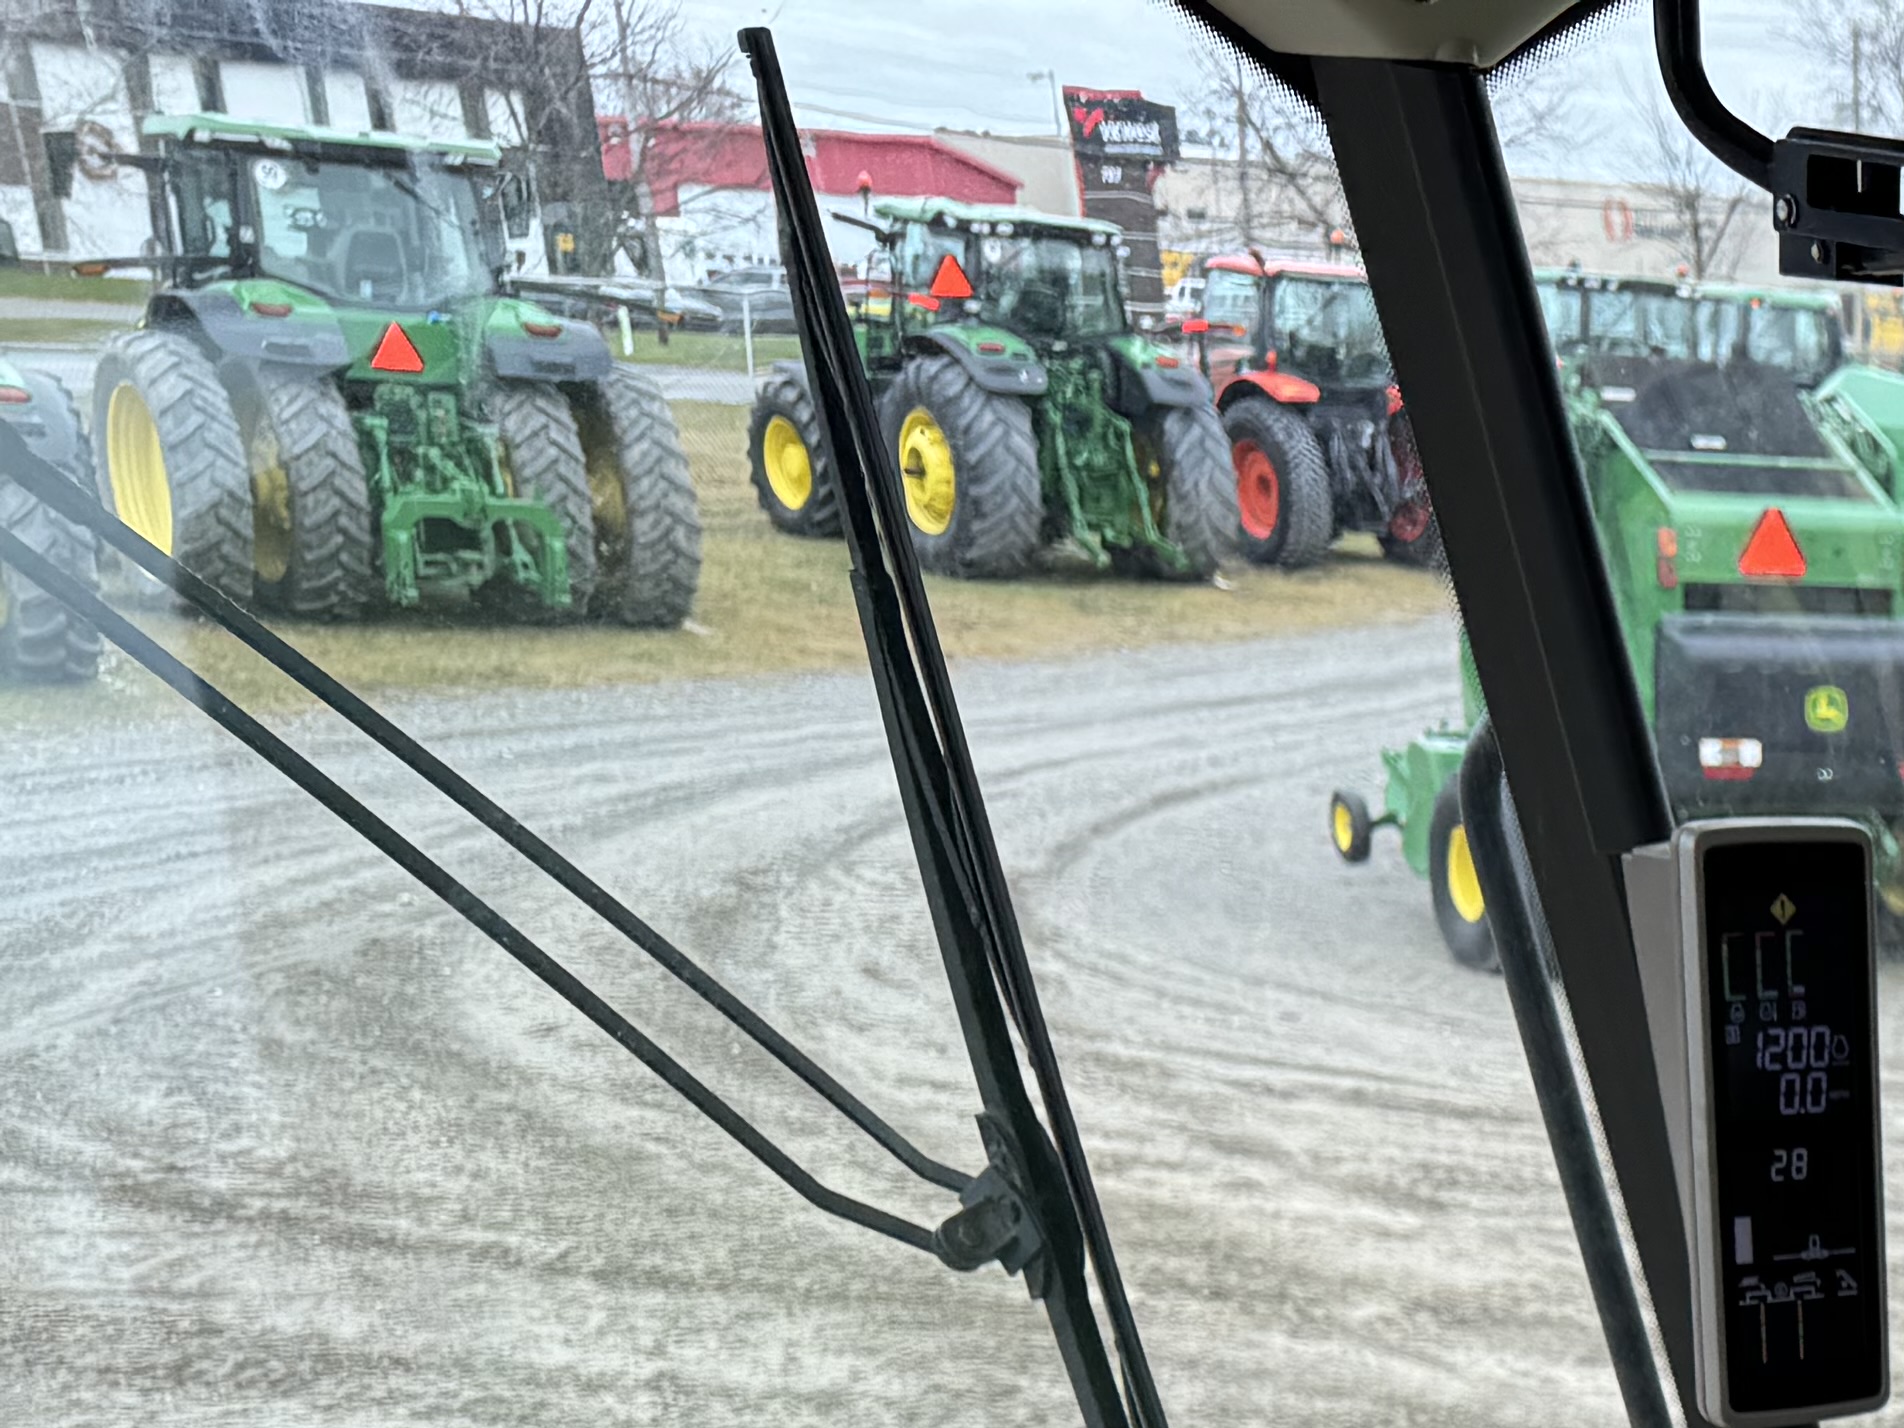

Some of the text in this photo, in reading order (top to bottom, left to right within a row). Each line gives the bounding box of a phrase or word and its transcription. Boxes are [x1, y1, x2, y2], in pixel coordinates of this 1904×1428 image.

[1757, 1025, 1831, 1070] 1200
[1780, 1072, 1828, 1116] 0.0
[1771, 1148, 1808, 1182] 28
